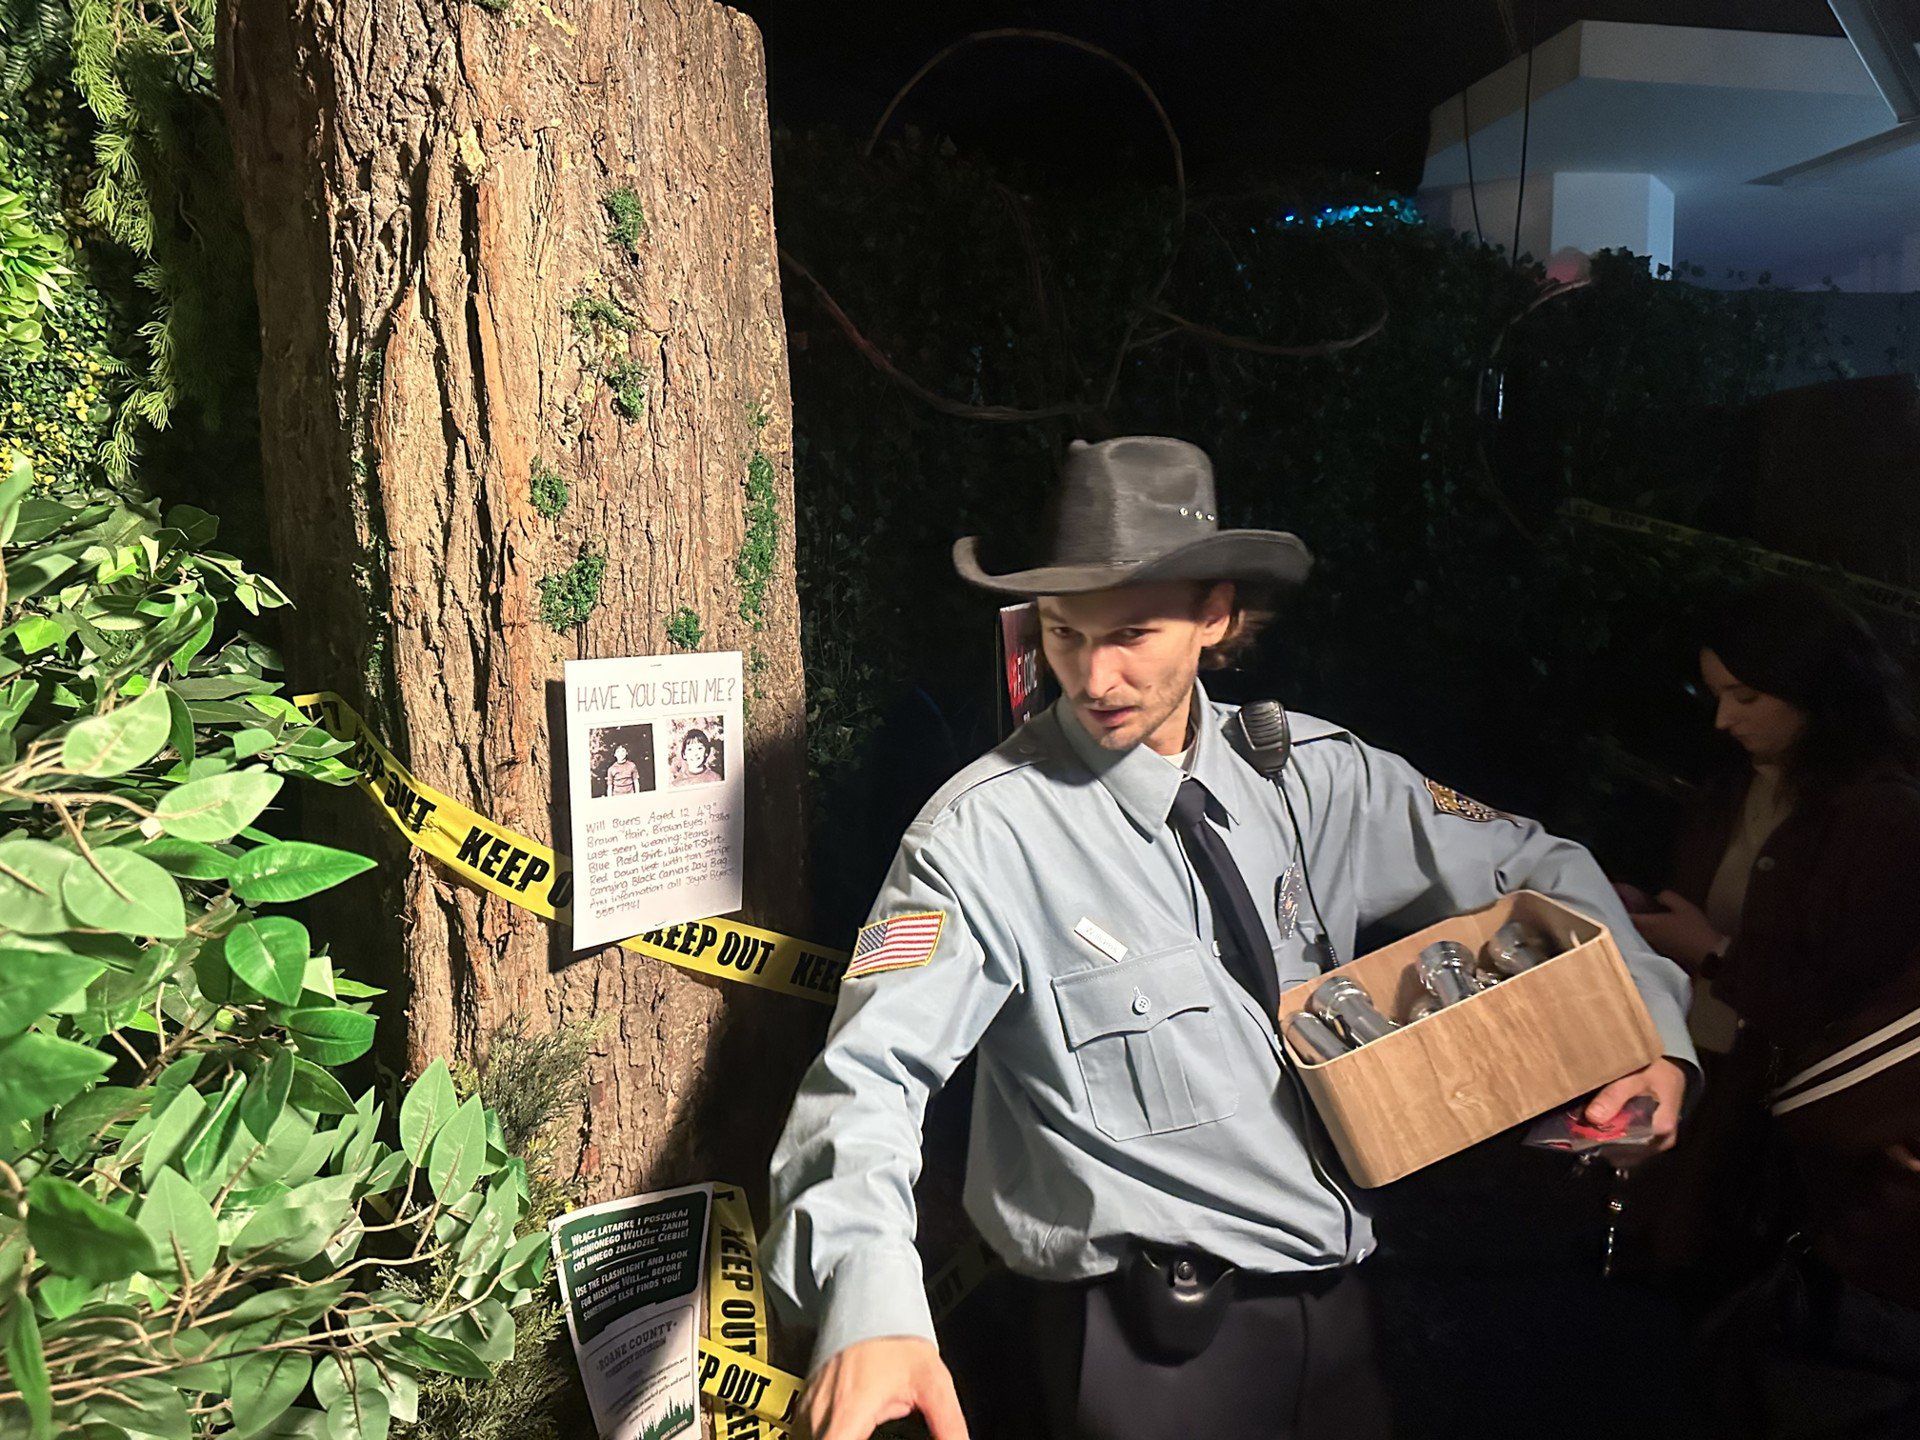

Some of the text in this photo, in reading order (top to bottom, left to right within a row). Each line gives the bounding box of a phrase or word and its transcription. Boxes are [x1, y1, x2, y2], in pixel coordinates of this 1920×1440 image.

[577, 677, 736, 712] HAVE YOU SEEN ME?
[383, 771, 438, 834] OUT
[585, 819, 606, 835] Will
[612, 814, 641, 831] Byers
[647, 809, 676, 826] Aged
[680, 808, 689, 818] 12
[586, 835, 619, 849] Brown
[652, 823, 682, 836] Brown
[456, 825, 550, 894] KEEP
[587, 848, 608, 861] Last
[612, 844, 637, 856] seen
[588, 862, 610, 875] Blue
[667, 842, 694, 856] White
[589, 873, 608, 886] Red
[614, 867, 640, 879] Down
[589, 857, 728, 897] Carrying Black Canvas Day Bag
[611, 883, 664, 903] information
[717, 931, 776, 975] OUT
[637, 1218, 642, 1226] I
[643, 1208, 689, 1224] POSZUKAJ
[661, 1219, 690, 1232] ZANIM
[615, 1236, 656, 1255] ZNAJDZIE
[657, 1228, 690, 1243] CIEBIE!
[574, 1250, 689, 1298] USE THE FLASHLIGHT AND LOOK
[592, 1281, 621, 1303] MISSING
[651, 1261, 683, 1277] BEFORE
[618, 1287, 634, 1302] ELSE
[636, 1277, 660, 1294] FINDS
[661, 1271, 682, 1285] YOU!
[629, 1320, 673, 1350] COUNTY
[721, 1299, 757, 1356] OUT
[716, 1363, 772, 1410] OUT
